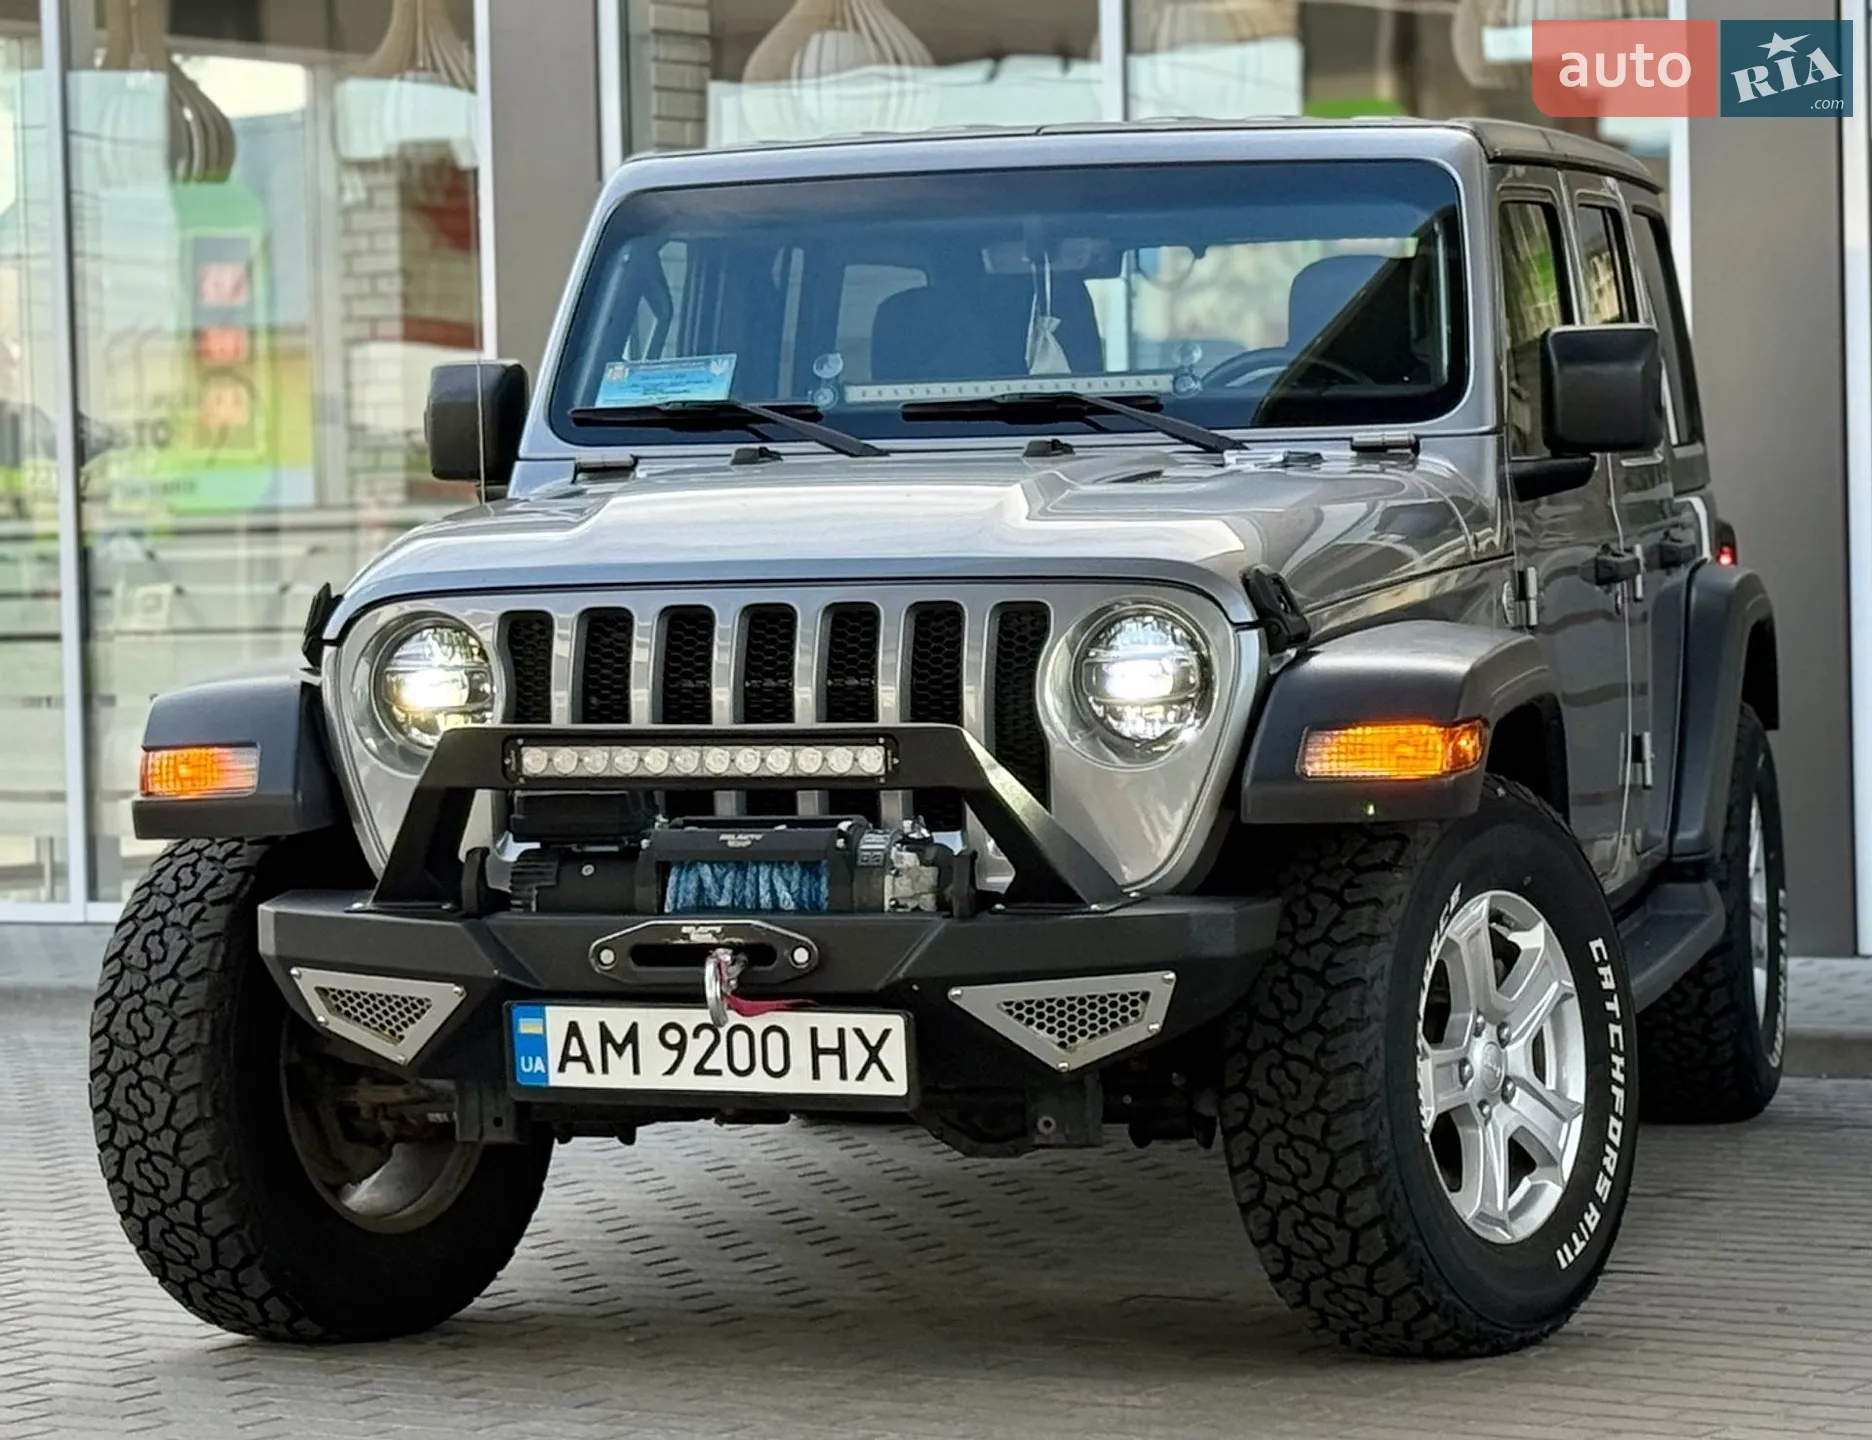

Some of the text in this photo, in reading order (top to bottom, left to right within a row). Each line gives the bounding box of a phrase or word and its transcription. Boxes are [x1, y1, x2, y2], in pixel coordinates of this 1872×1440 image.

[520, 1056, 546, 1074] UA
[557, 1020, 895, 1082] AM 9200 HX
[1588, 936, 1626, 1204] CATCHFORS
